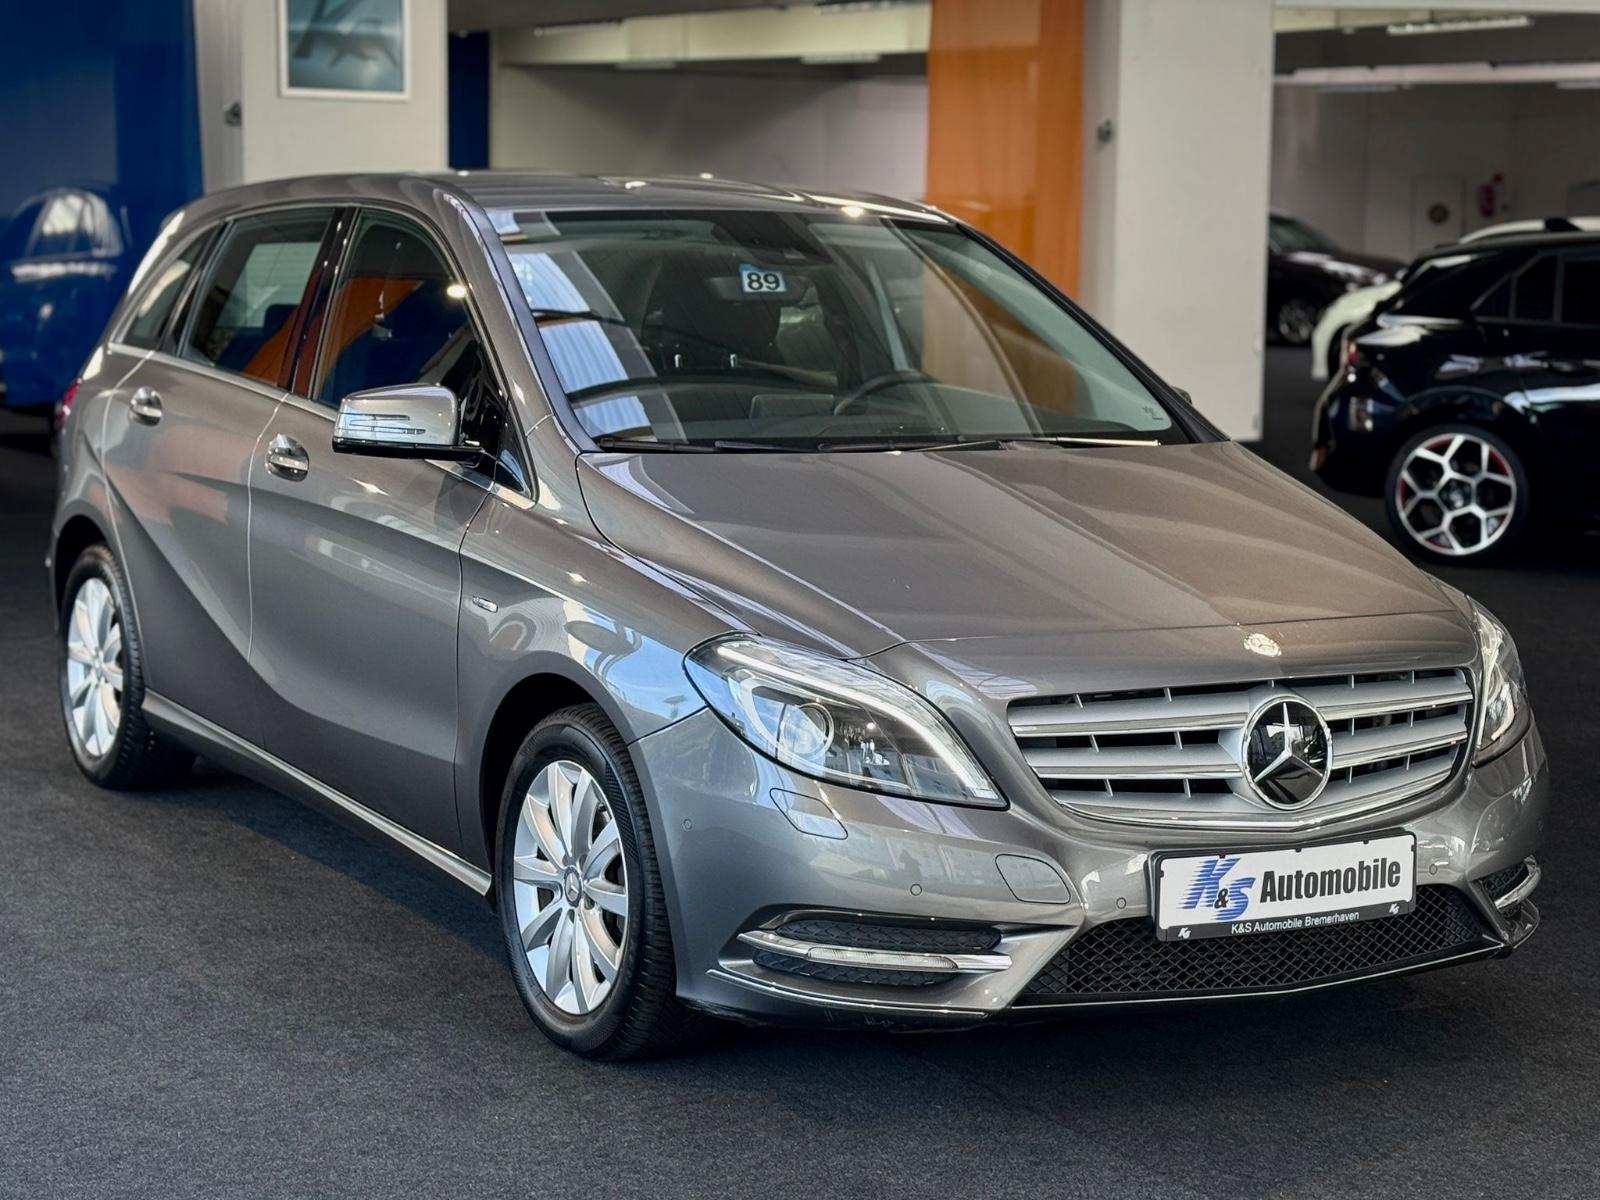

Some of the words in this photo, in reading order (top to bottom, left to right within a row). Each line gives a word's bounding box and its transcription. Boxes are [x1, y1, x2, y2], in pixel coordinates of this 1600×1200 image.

[747, 272, 780, 290] 89
[1178, 857, 1256, 921] K&S
[1259, 857, 1401, 903] Automobile
[1231, 921, 1252, 934] K&S
[1254, 918, 1303, 932] Automobile
[1305, 911, 1360, 927] Bremerhaven
